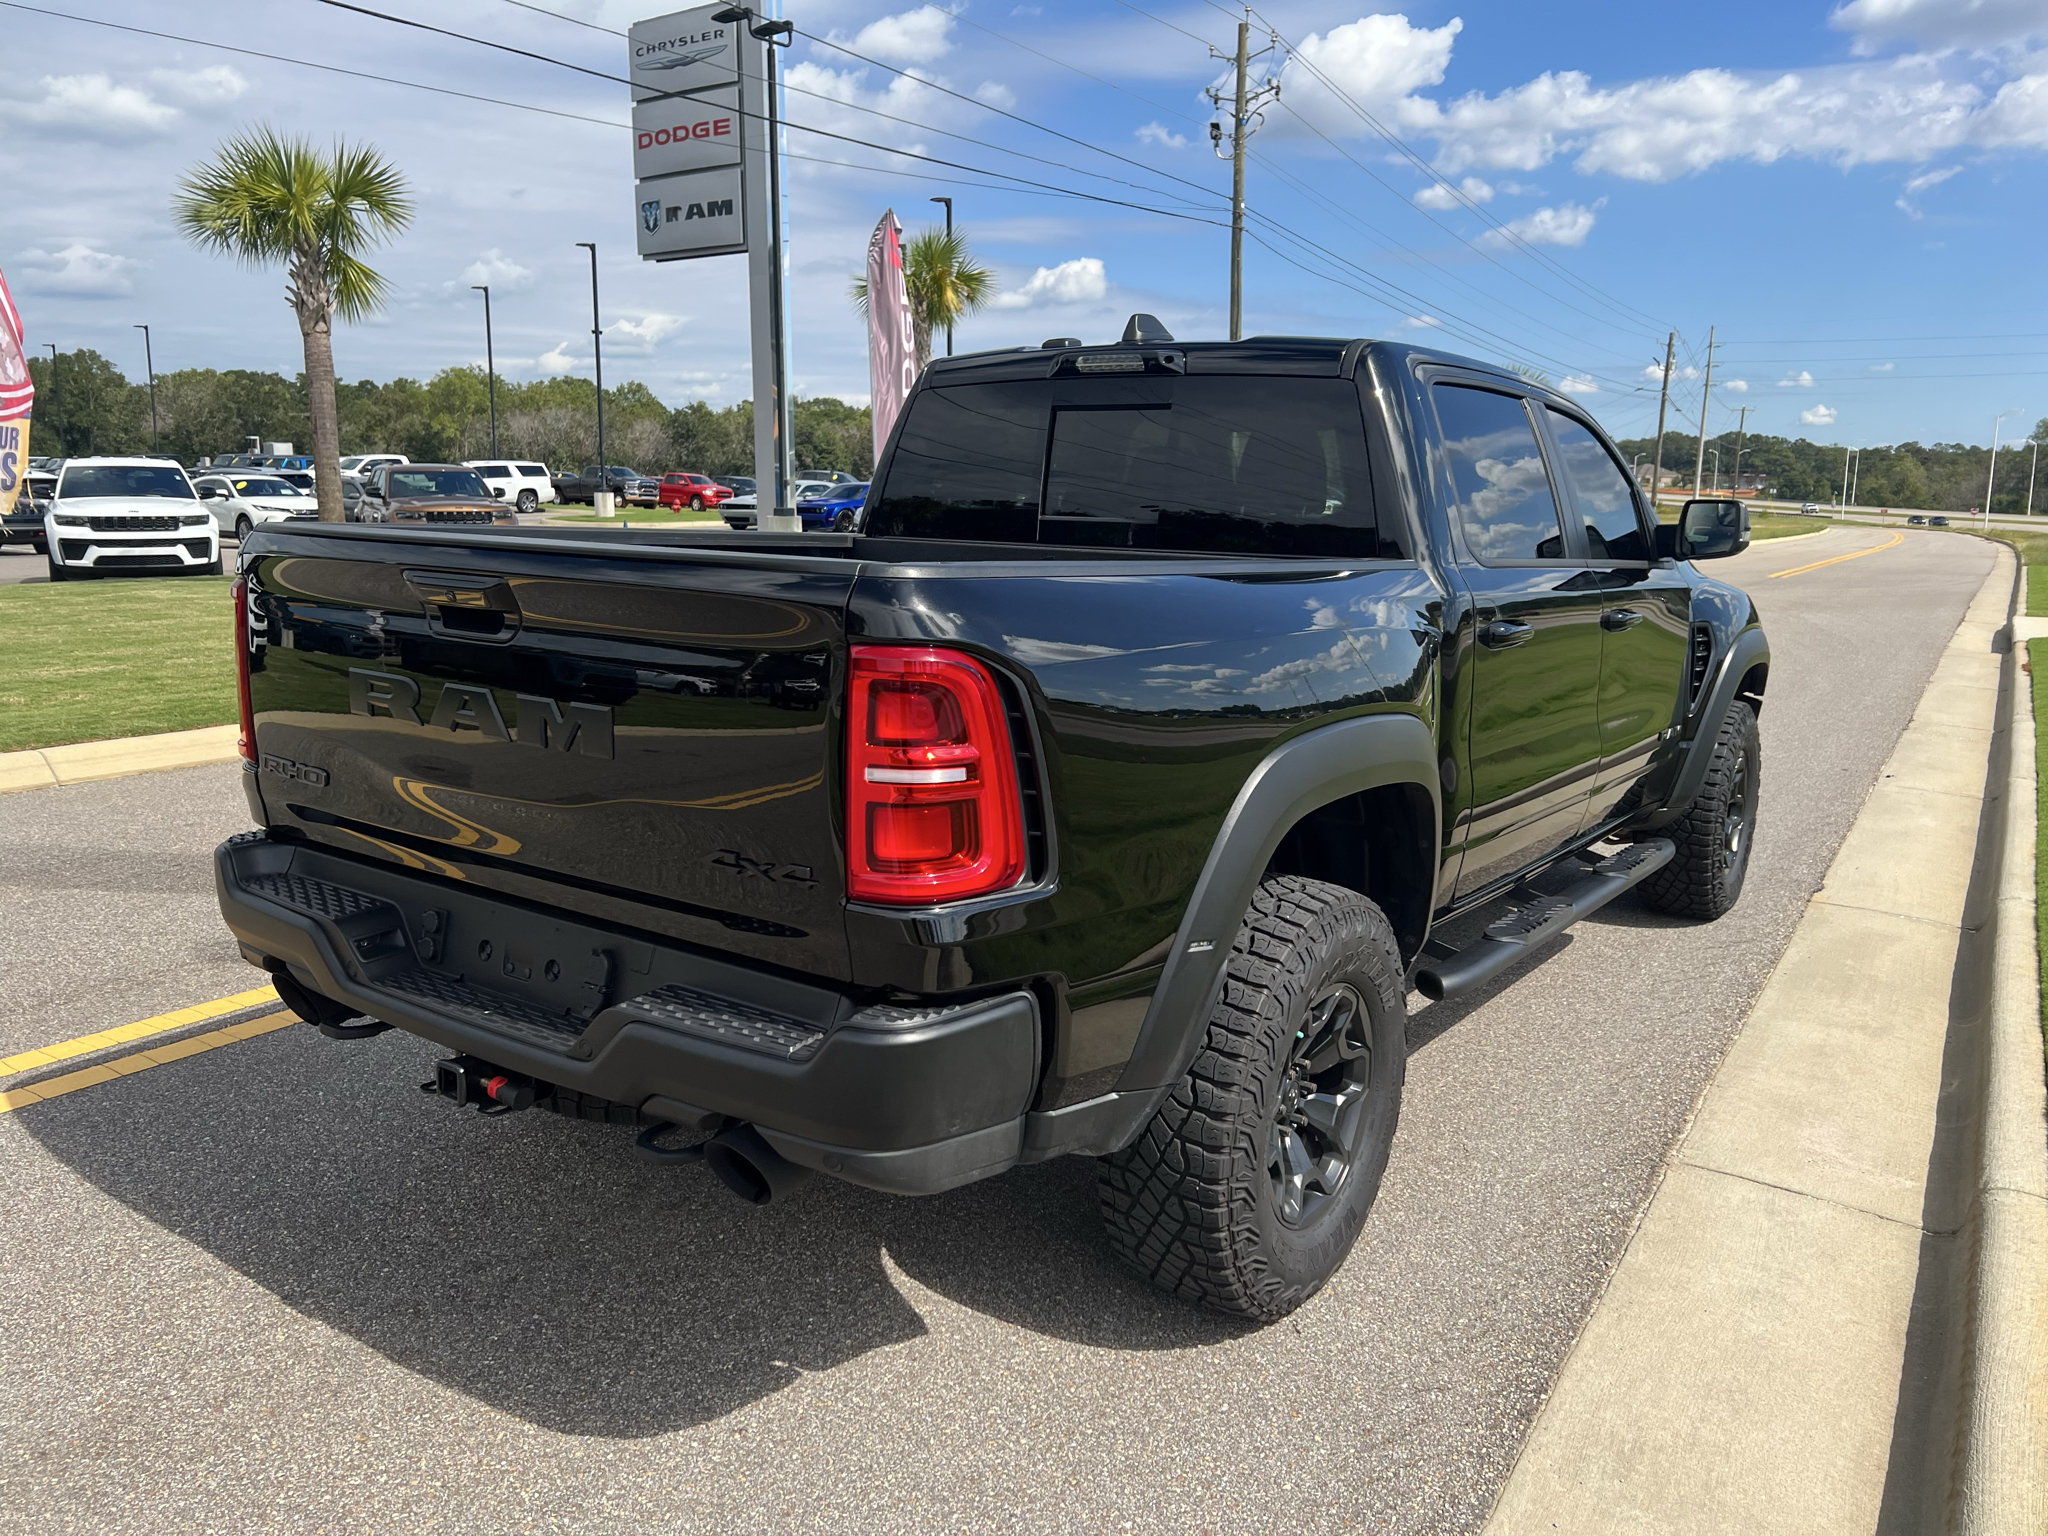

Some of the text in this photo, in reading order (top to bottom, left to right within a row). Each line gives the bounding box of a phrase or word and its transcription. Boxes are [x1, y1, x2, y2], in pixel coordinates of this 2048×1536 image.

[635, 29, 725, 57] CHRYSLER
[638, 118, 731, 150] DODGE
[665, 199, 733, 223] RAM
[0, 426, 20, 450] UR
[348, 666, 615, 760] RAM
[262, 753, 330, 787] RHO
